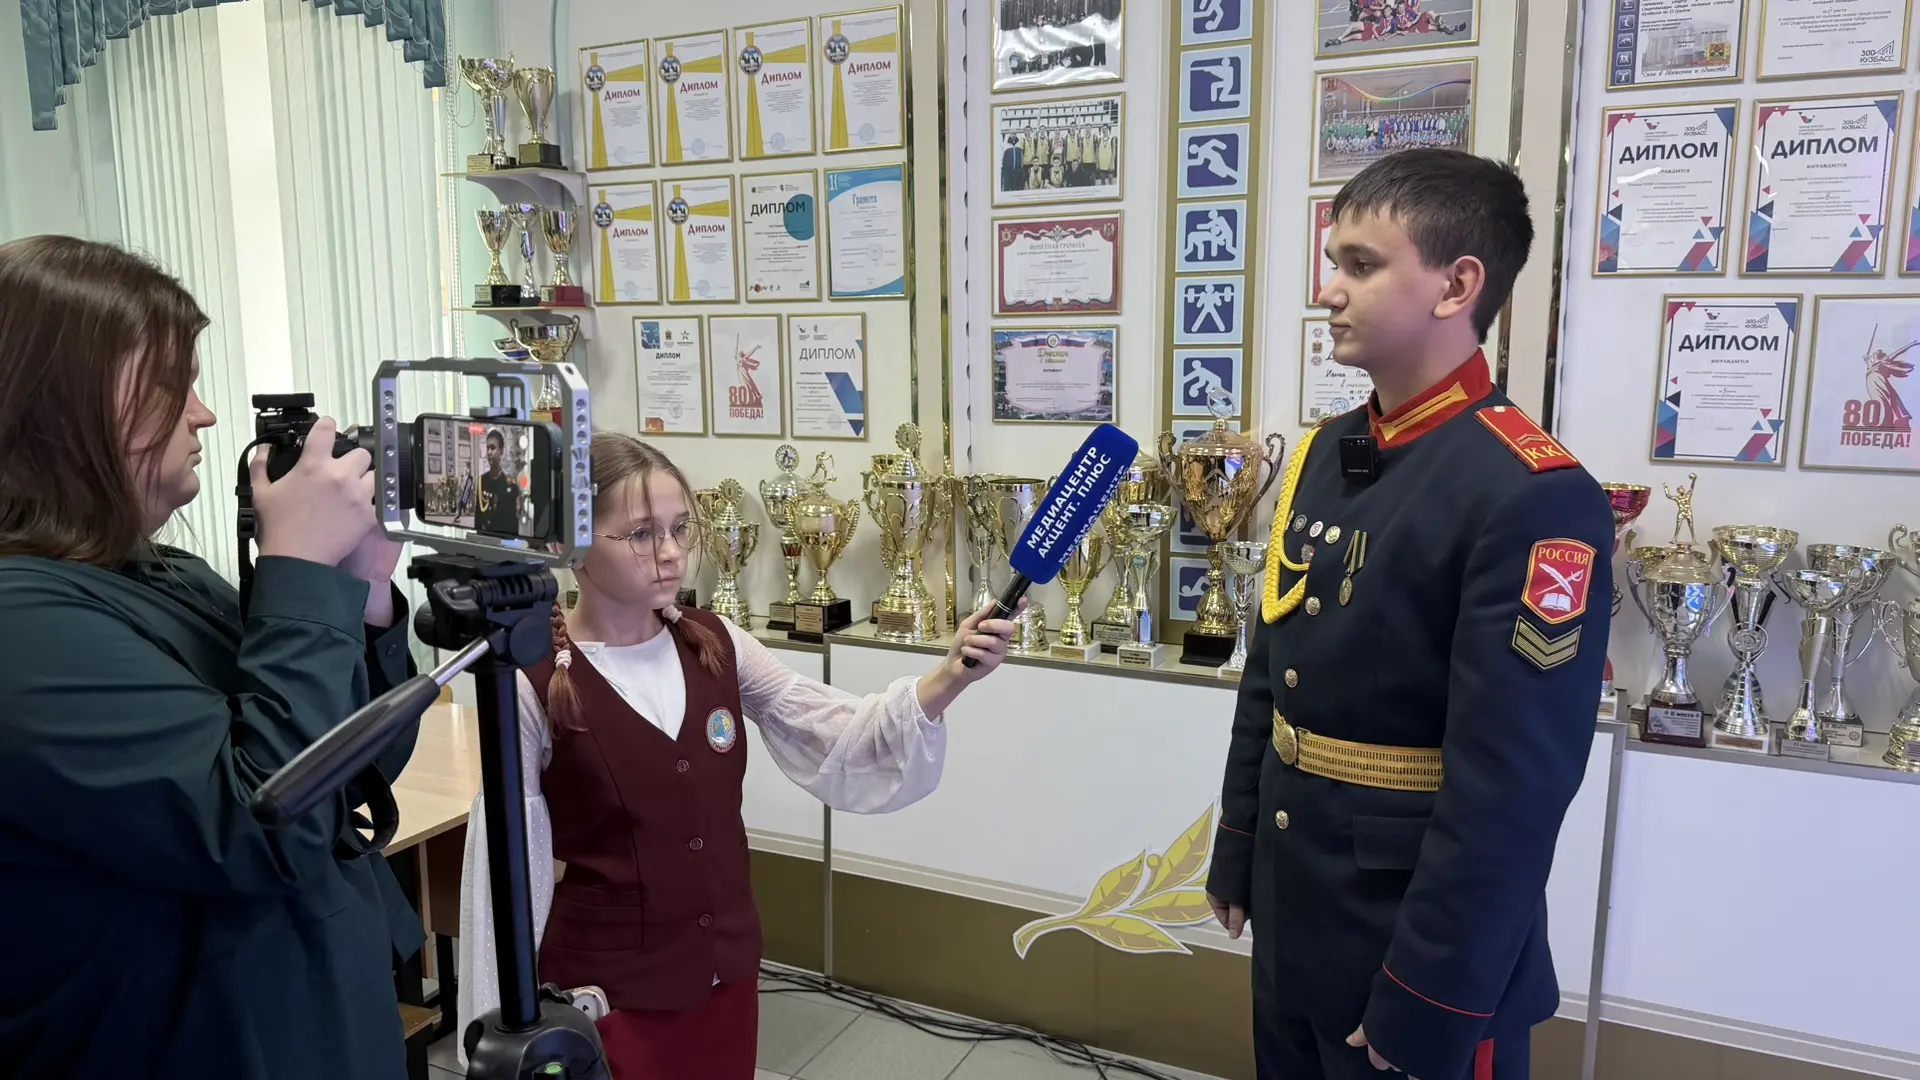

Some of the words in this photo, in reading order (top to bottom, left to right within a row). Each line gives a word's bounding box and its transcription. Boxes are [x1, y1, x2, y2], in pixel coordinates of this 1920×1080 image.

[1860, 55, 1894, 63] КУЗБАСС
[1619, 142, 1718, 164] ДИПЛОМ
[1771, 136, 1878, 159] ДИПЛОМ
[852, 193, 877, 206] Грамота
[751, 201, 805, 217] ДИПЛОМ
[1678, 334, 1779, 352] ДИПЛОМ
[656, 352, 681, 360] ДИПЛОМ
[799, 348, 856, 361] ДИПЛОМ
[729, 386, 747, 404] 80
[729, 408, 764, 420] ПОБЕДА!
[1843, 399, 1880, 426] 80
[1840, 432, 1911, 449] ПОБЕДА!
[1026, 446, 1097, 549] МЕДИАЦЕНТР
[1038, 501, 1081, 558] АКЦЕНТ.
[1077, 453, 1112, 498] ПЛЮС
[1537, 546, 1590, 565] РОССИЯ
